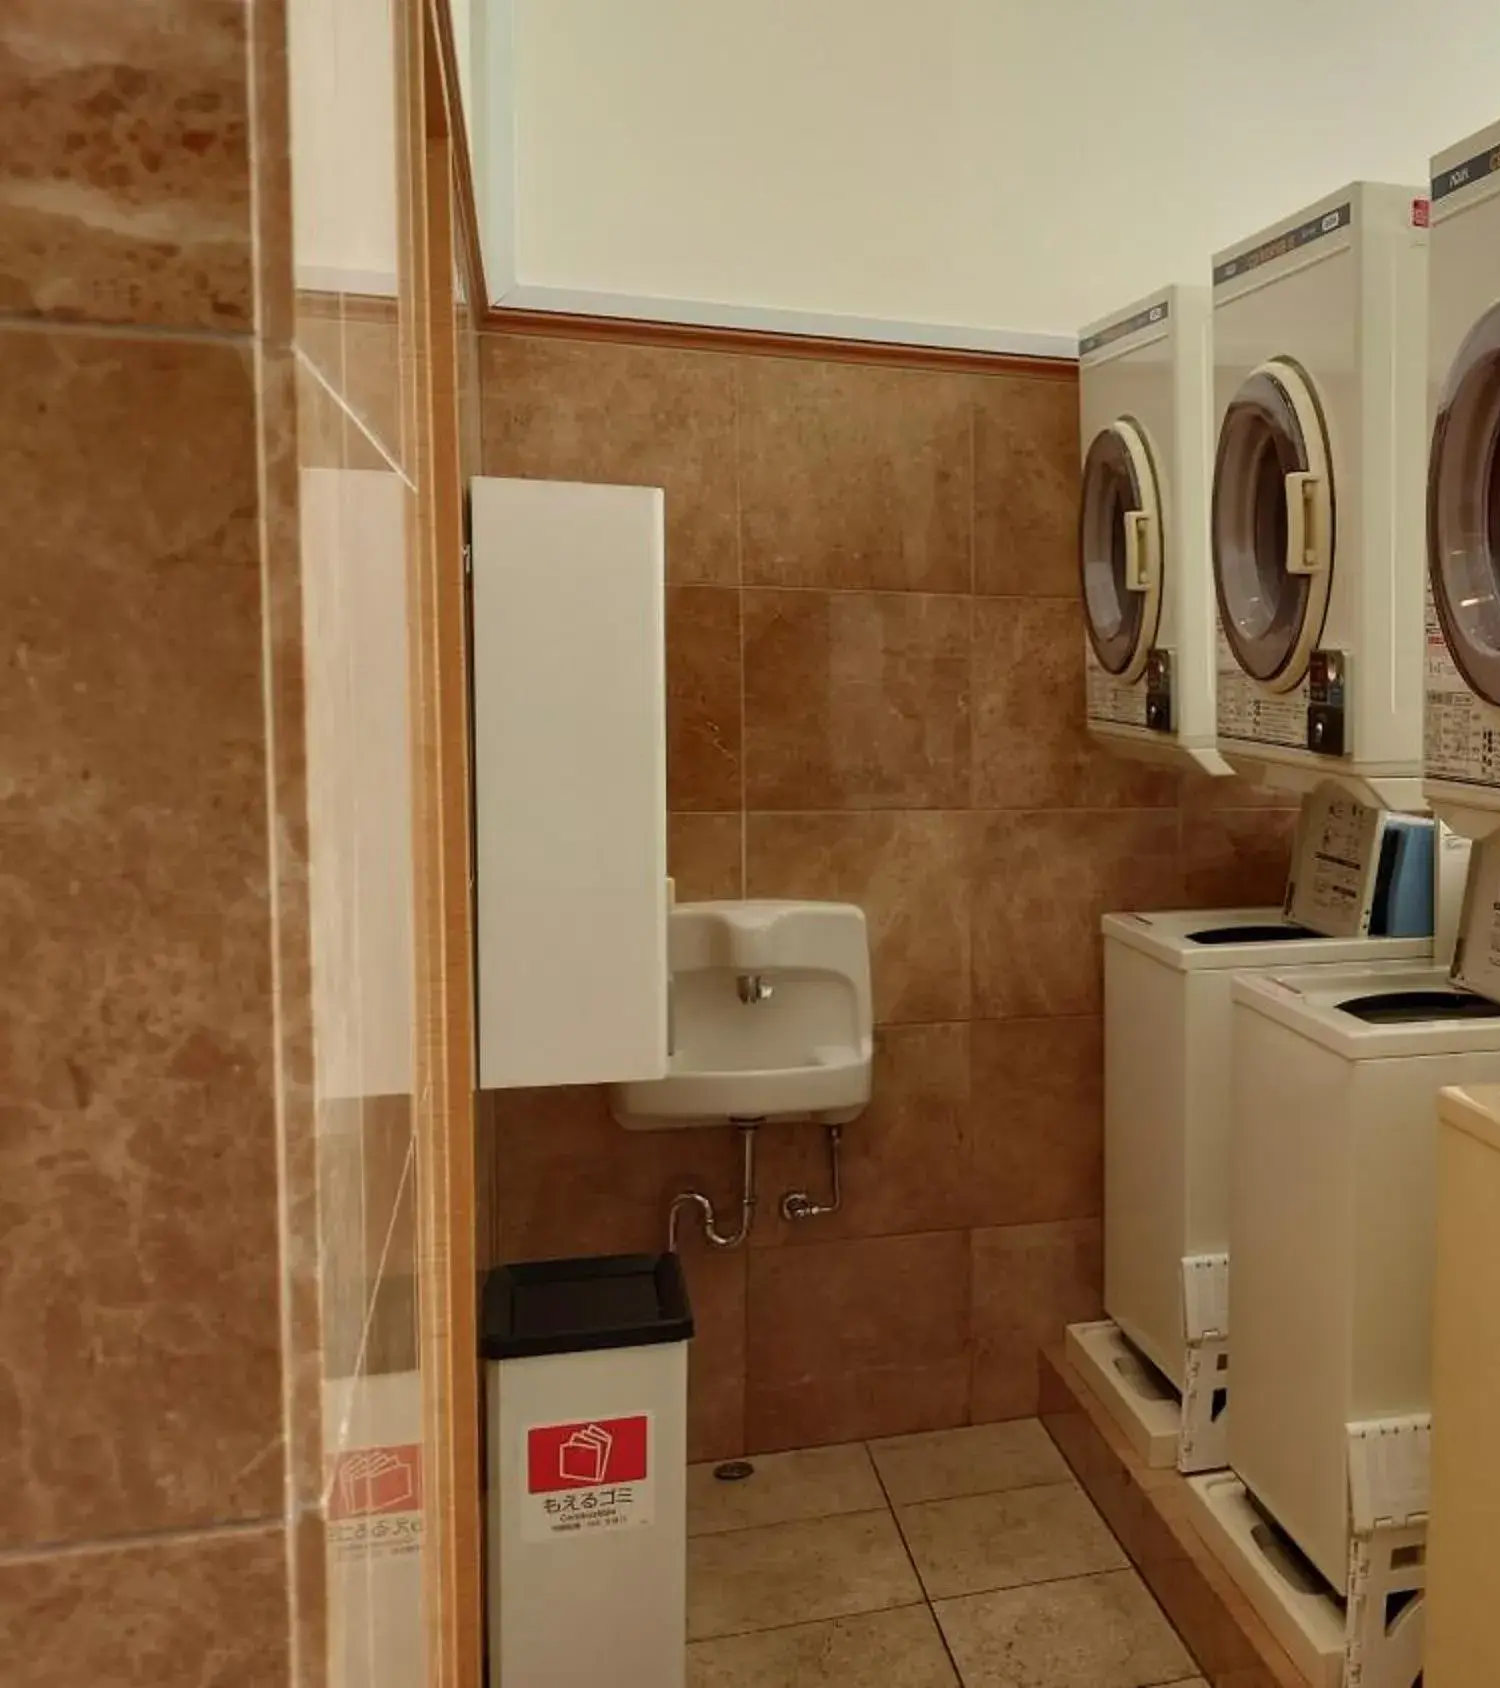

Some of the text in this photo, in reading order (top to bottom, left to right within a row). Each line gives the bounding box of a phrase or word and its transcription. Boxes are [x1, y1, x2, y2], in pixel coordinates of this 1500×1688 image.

[544, 1487, 633, 1513] もえるゴミ
